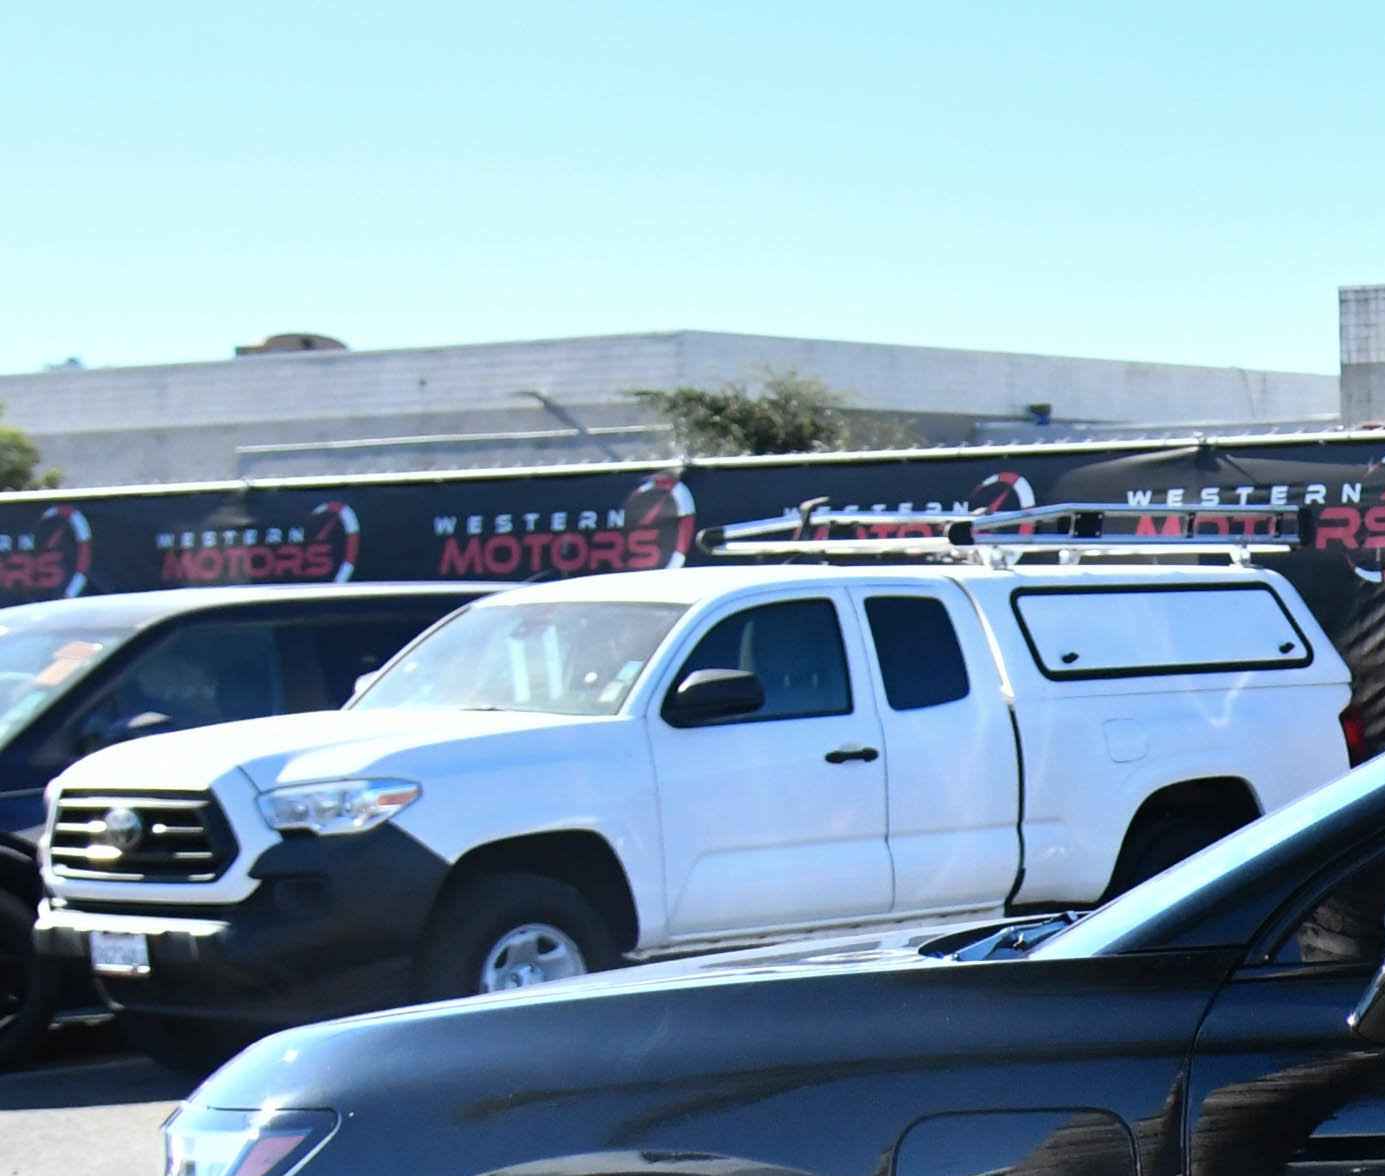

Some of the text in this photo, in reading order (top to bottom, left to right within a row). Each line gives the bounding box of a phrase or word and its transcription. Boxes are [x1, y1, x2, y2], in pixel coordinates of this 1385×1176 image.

[1127, 483, 1362, 507] WESTERN
[434, 509, 625, 536] WESTERN
[156, 528, 305, 549] WESTERN
[161, 545, 334, 581] MOTORS
[439, 529, 662, 576] MOTORS
